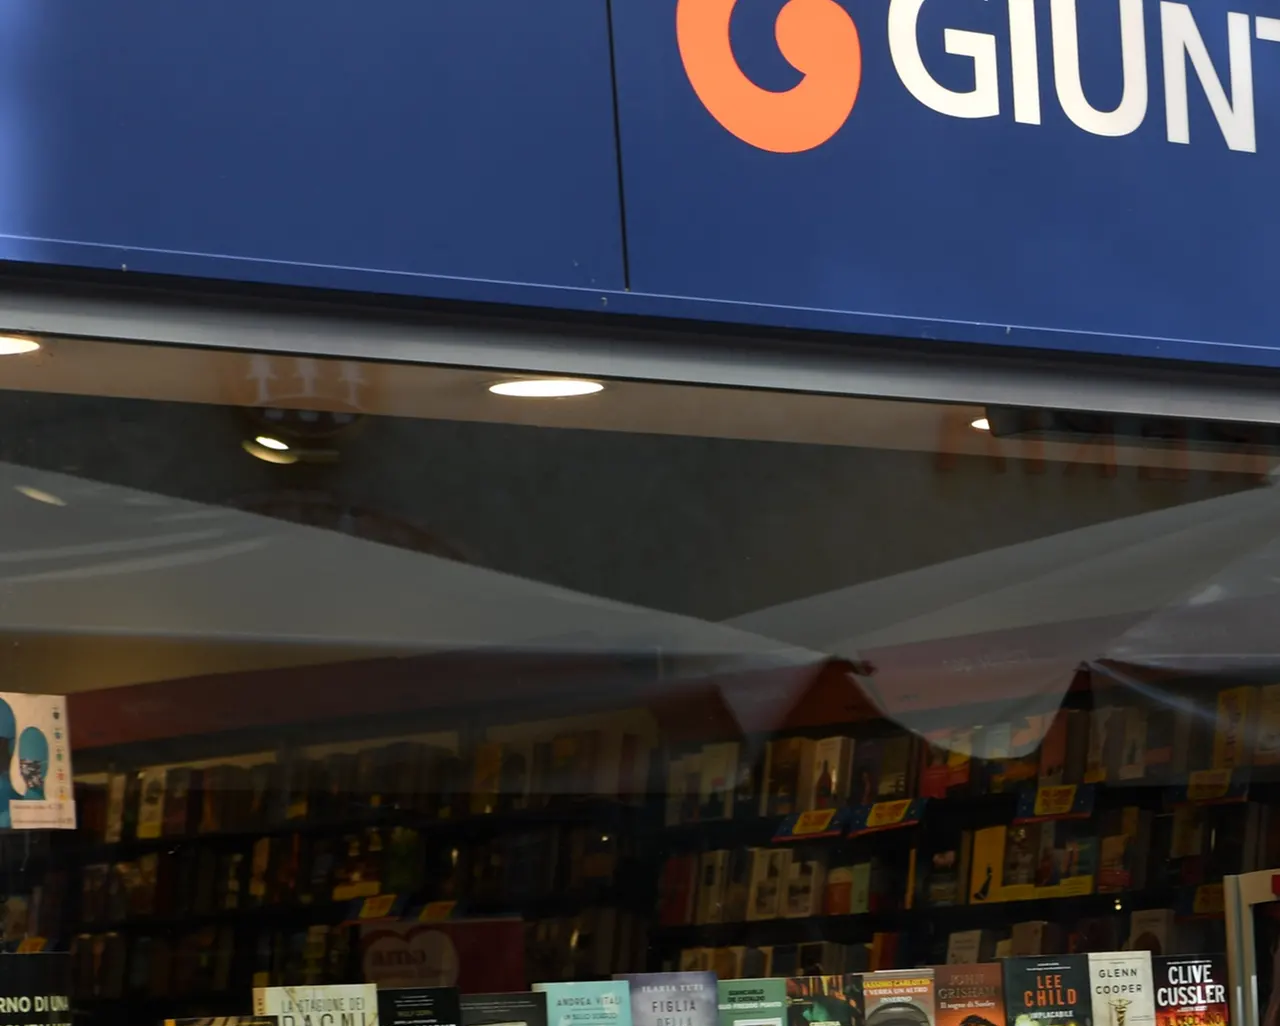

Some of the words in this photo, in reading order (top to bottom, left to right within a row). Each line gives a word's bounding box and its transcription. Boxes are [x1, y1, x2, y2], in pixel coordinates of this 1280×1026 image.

[1098, 969, 1138, 979] GLENN
[1168, 964, 1213, 985] CLIVE
[1036, 974, 1062, 990] LEE
[938, 987, 997, 1000] GRISHAM
[1096, 984, 1143, 995] COOPER
[1157, 984, 1225, 1006] CUSSLER
[34, 996, 49, 1012] DI
[557, 998, 591, 1006] ANDREA
[1024, 989, 1077, 1007] CHILD
[652, 1000, 697, 1013] FIGLIA
[1030, 1010, 1074, 1018] IMPLACABILE
